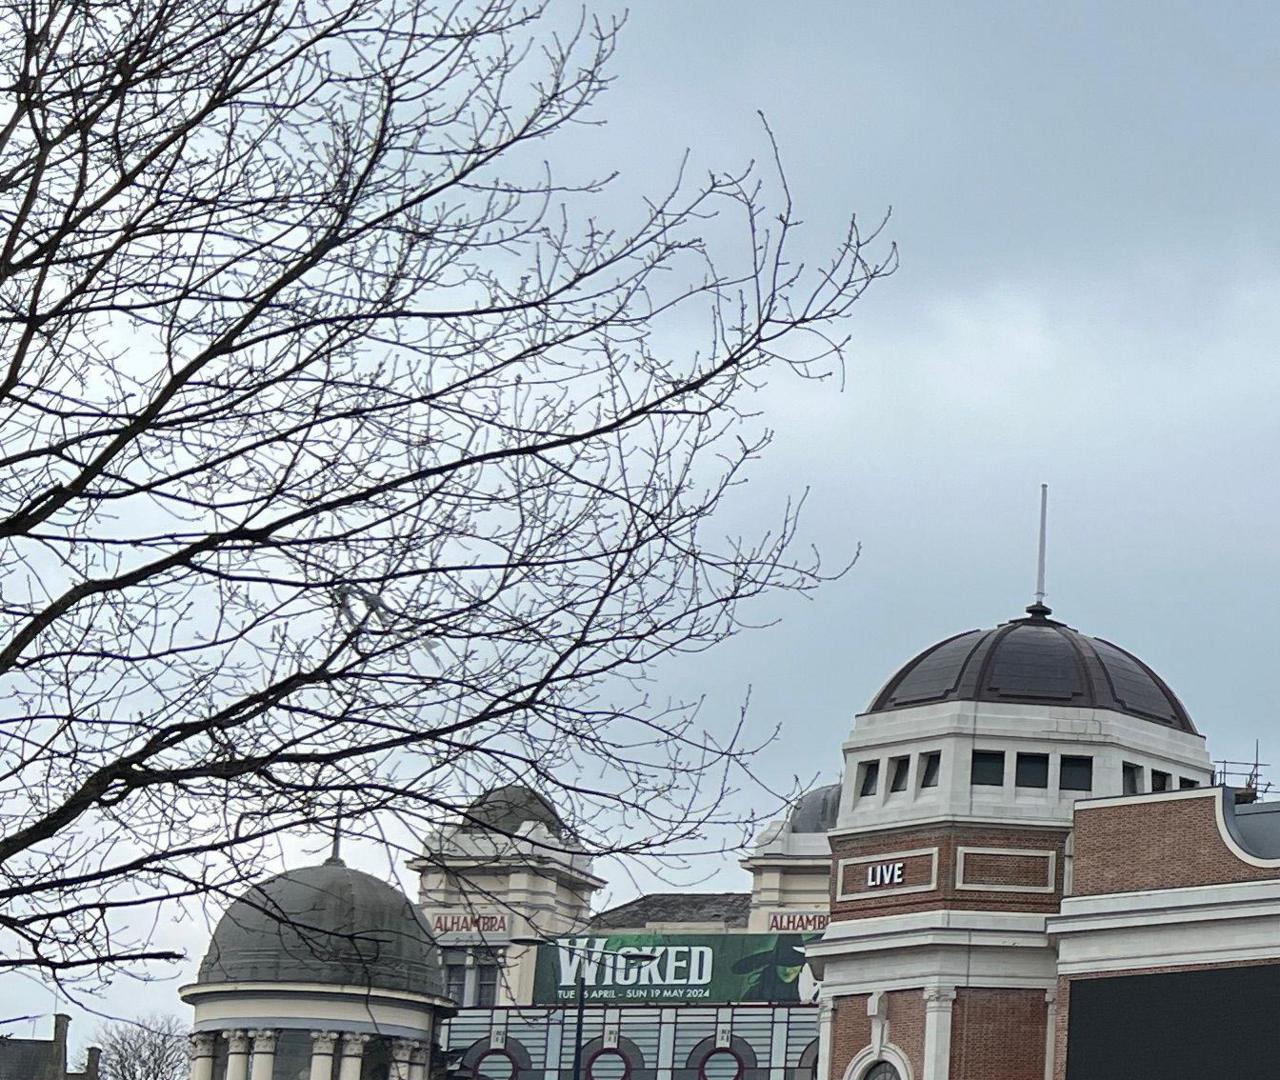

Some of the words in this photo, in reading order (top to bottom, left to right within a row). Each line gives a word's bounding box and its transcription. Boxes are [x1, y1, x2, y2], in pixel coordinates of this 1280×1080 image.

[867, 862, 904, 887] LIVE
[434, 915, 506, 932] ALHAMBRA
[558, 989, 575, 999] TUE
[590, 989, 616, 998] APRIL
[626, 989, 647, 998] SUN
[650, 988, 661, 998] 19
[663, 988, 684, 998] MAY
[686, 988, 710, 998] 2024
